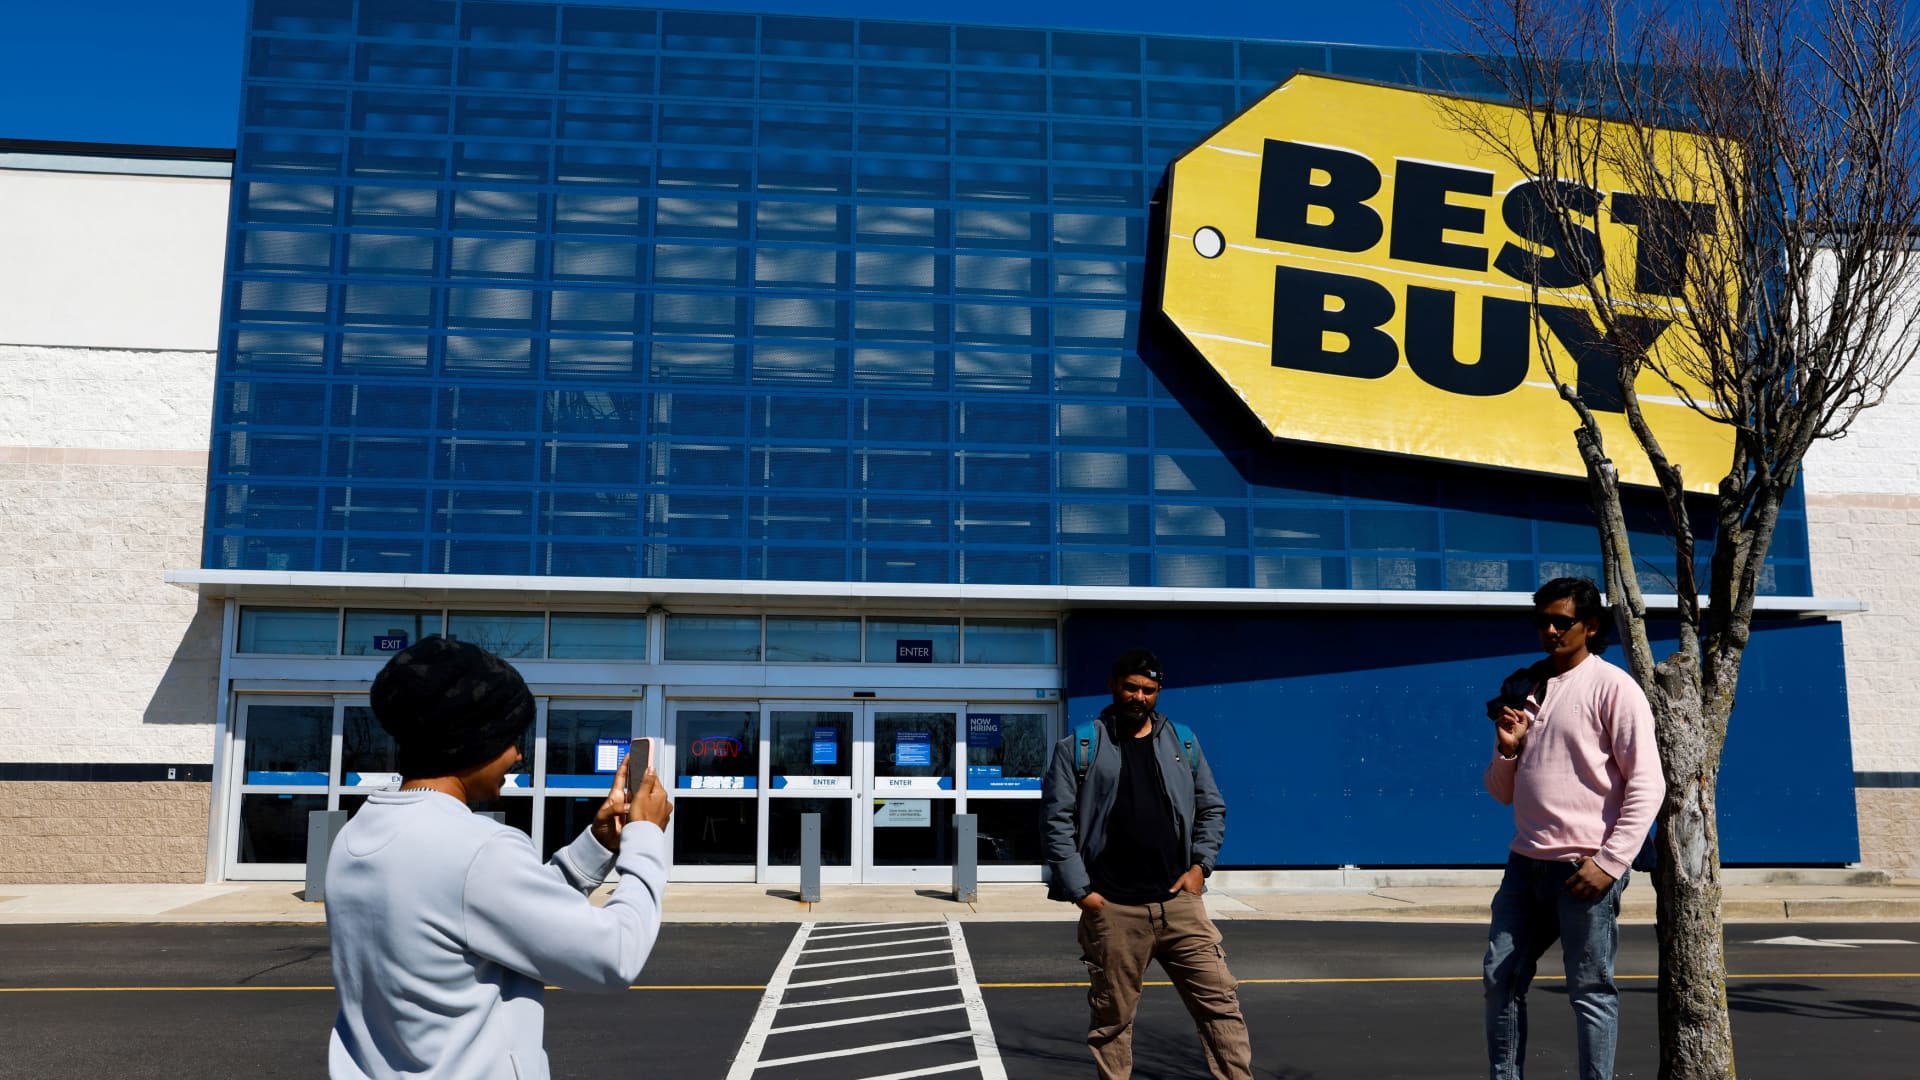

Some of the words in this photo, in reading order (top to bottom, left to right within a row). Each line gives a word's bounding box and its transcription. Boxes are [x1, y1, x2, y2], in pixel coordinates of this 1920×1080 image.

[1255, 137, 1717, 298] BEST
[1271, 264, 1675, 414] BUY
[381, 639, 401, 649] EXIT
[900, 647, 929, 657] ENTER
[691, 739, 739, 758] OPEN
[391, 775, 402, 783] EX
